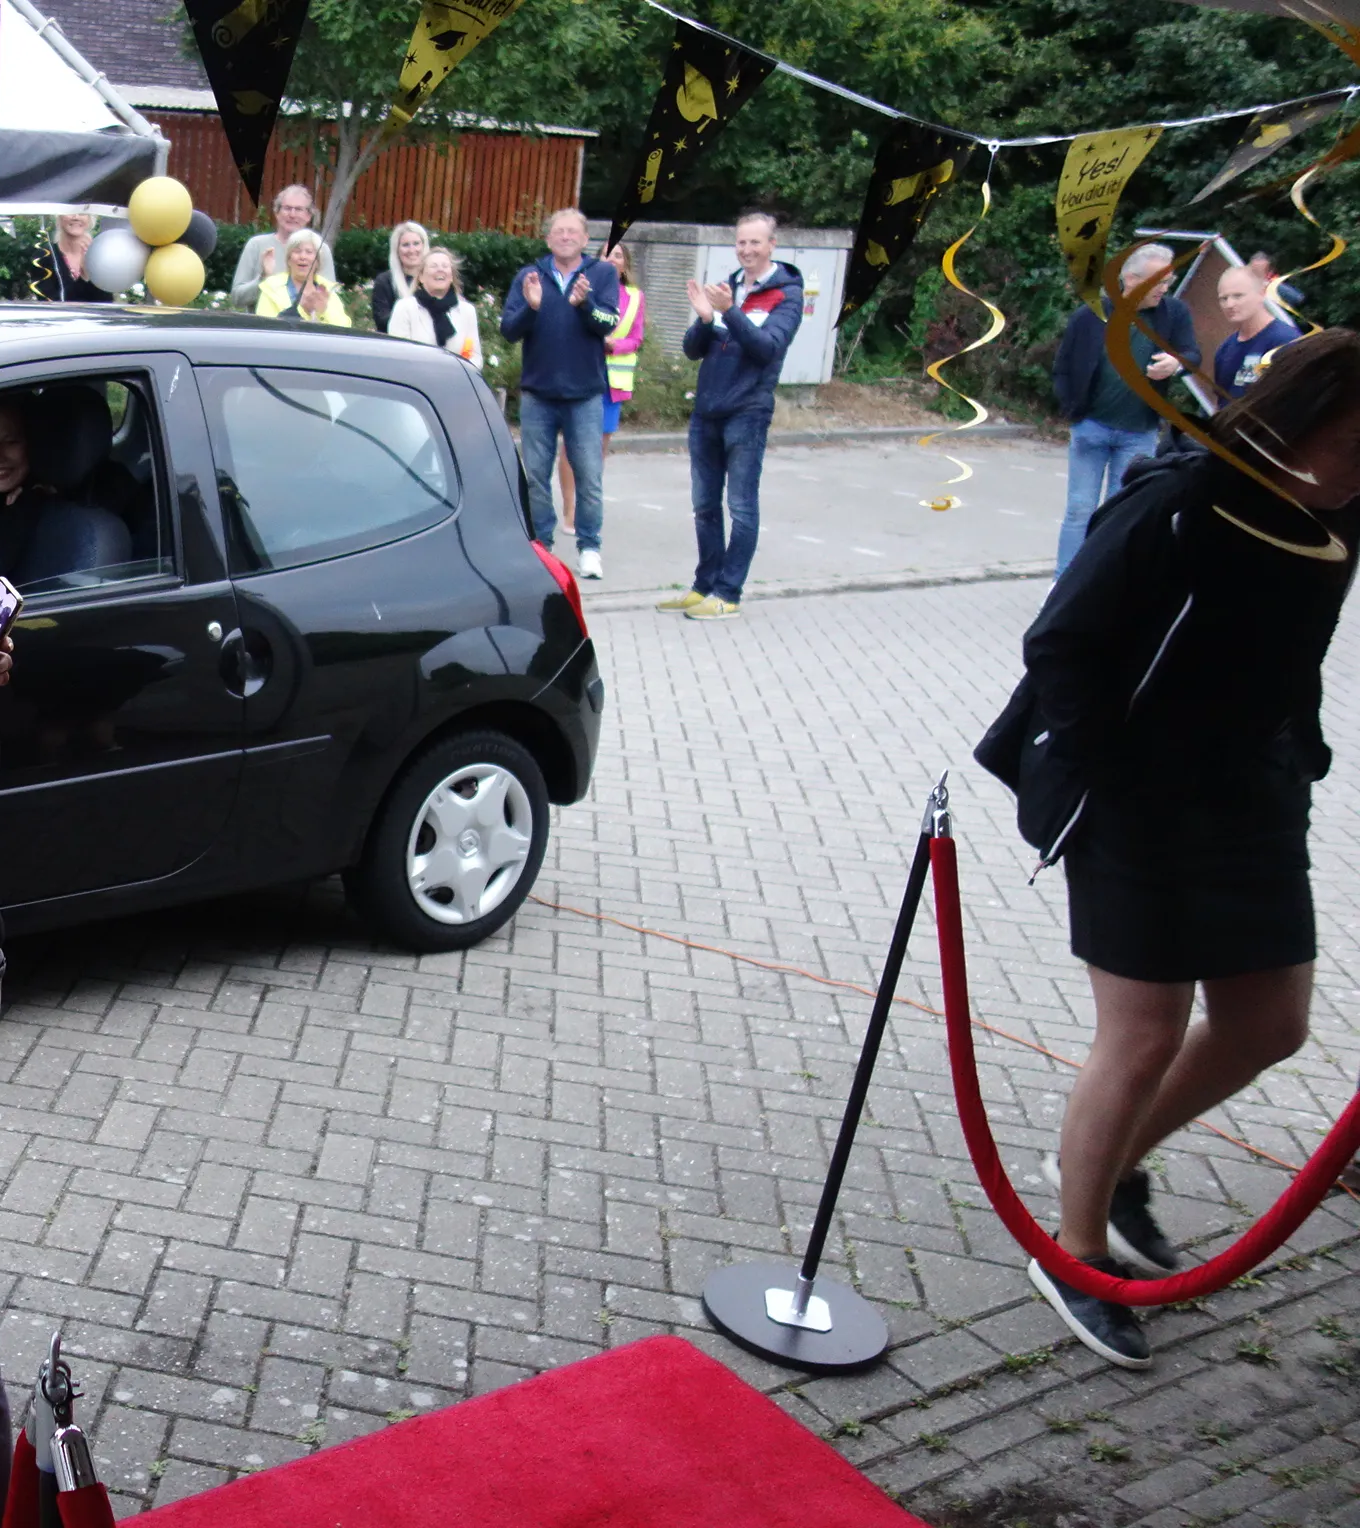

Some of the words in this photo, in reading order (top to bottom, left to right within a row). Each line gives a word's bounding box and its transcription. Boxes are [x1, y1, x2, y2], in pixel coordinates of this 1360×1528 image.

[1077, 146, 1130, 187] Yes!
[1061, 192, 1084, 209] You
[1085, 181, 1107, 201] did
